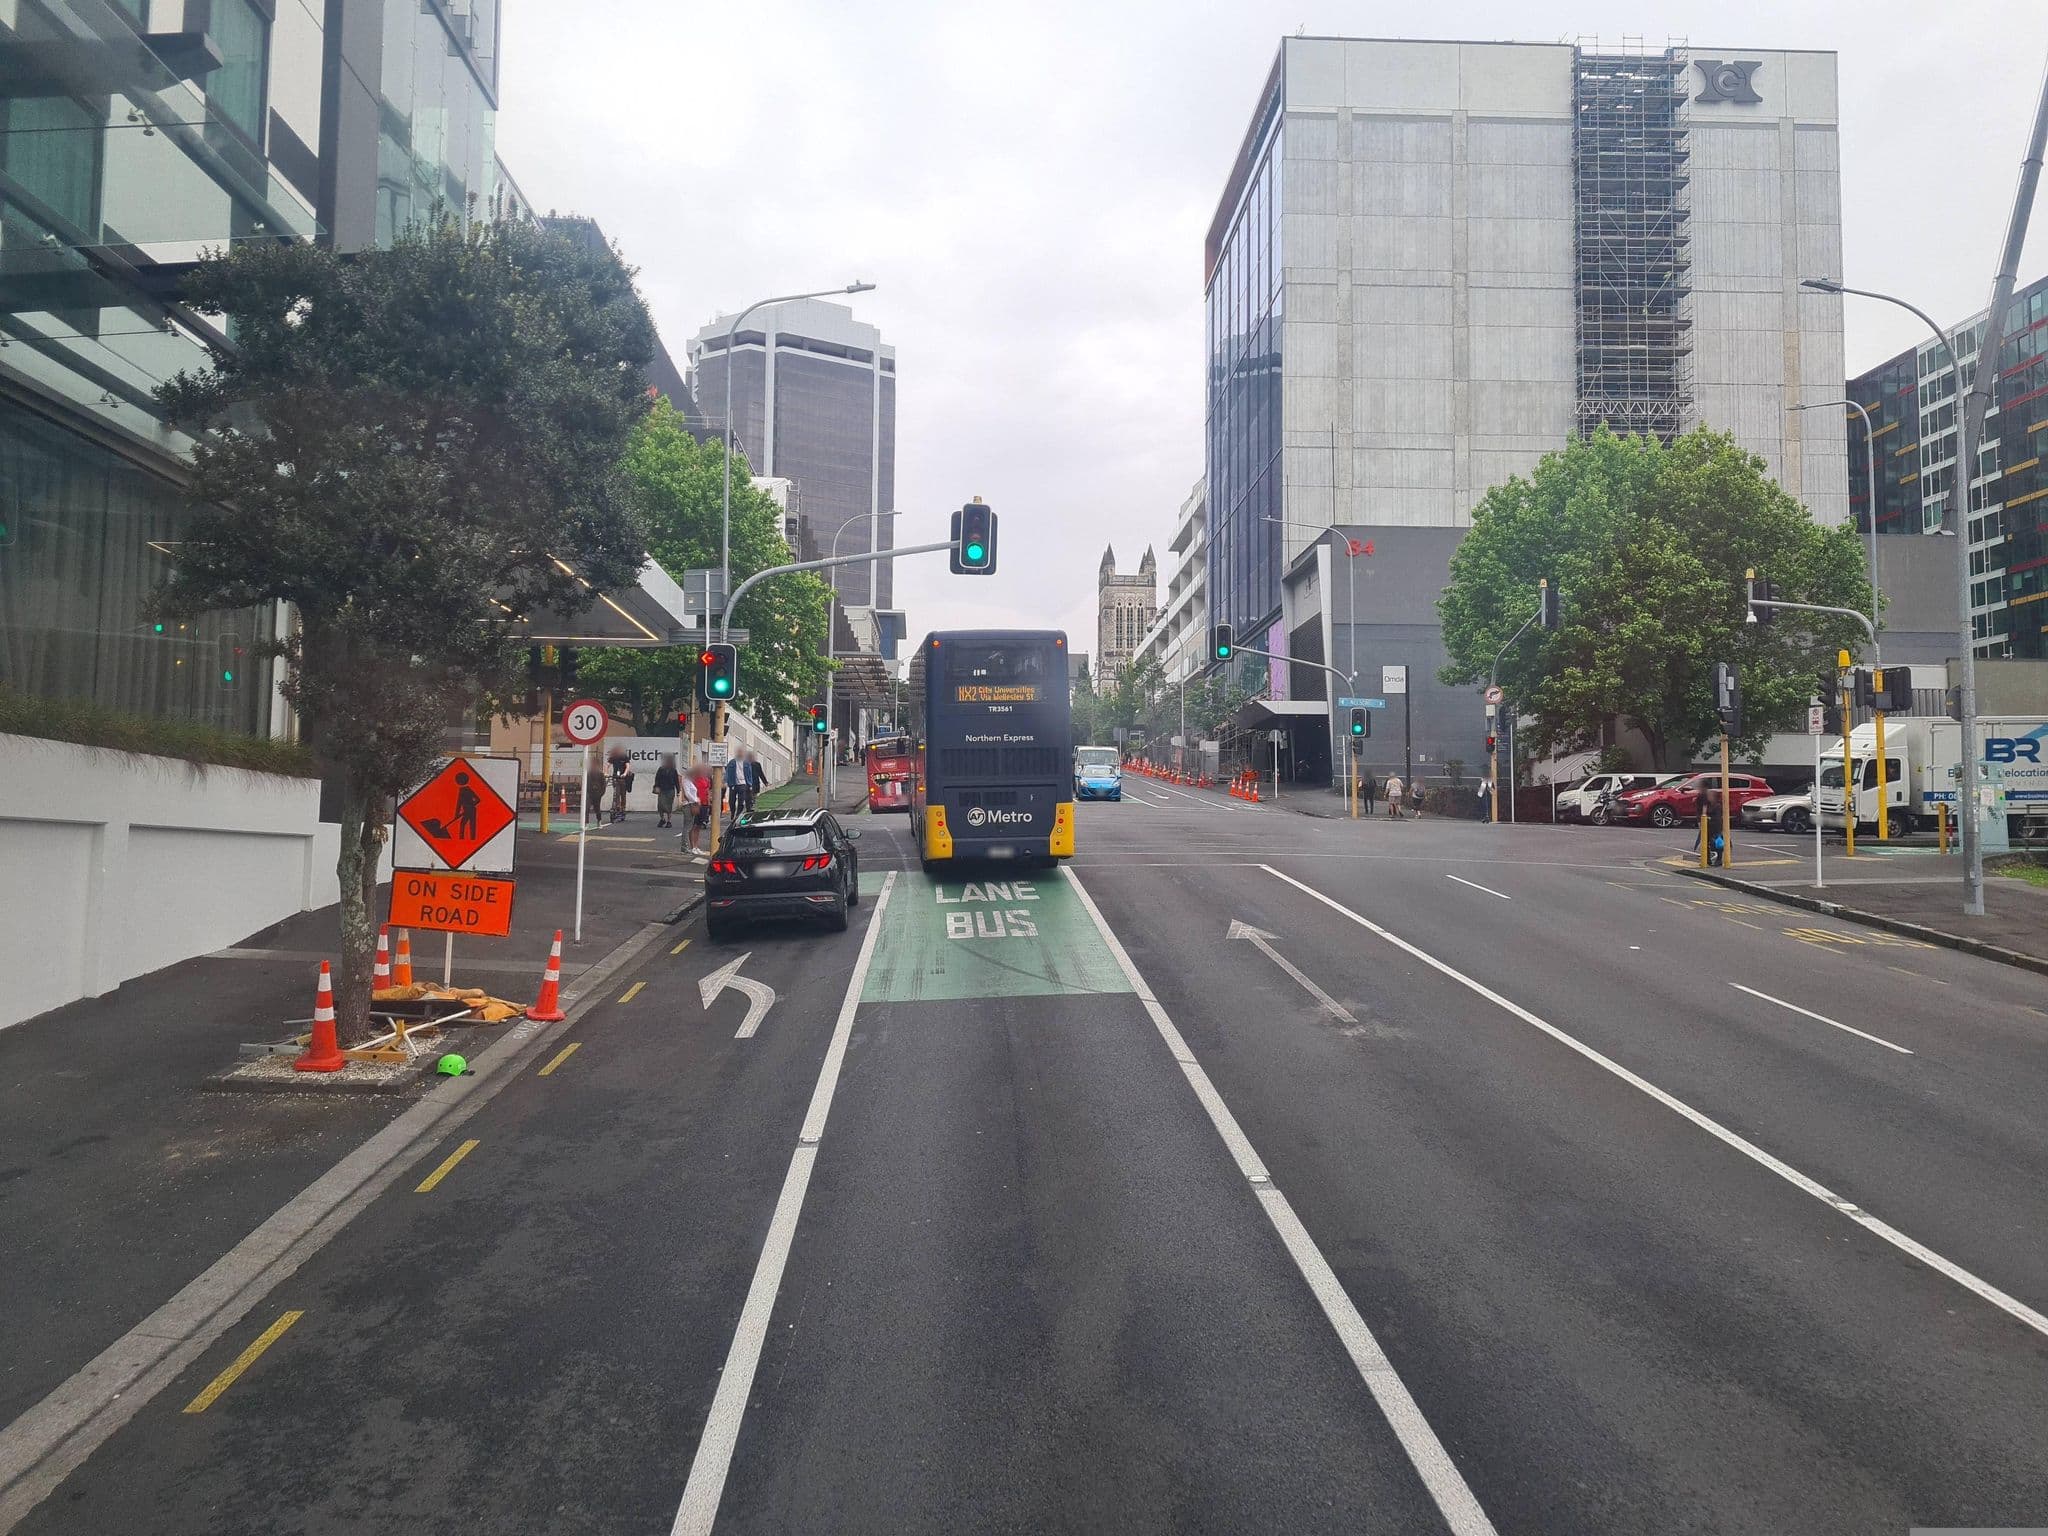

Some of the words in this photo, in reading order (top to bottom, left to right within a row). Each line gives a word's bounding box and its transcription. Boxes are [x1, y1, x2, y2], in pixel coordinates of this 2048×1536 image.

[959, 686, 977, 701] NX2
[978, 686, 992, 694] City
[994, 686, 1035, 694] Universities
[573, 714, 598, 731] 30
[965, 734, 1001, 742] Northern
[1003, 734, 1034, 744] Express
[621, 749, 679, 761] letchr
[1985, 738, 2041, 763] BR
[2003, 768, 2048, 778] elocatio
[988, 809, 1032, 823] Metro
[407, 879, 438, 898] ON
[450, 883, 498, 904] SIDE
[935, 880, 1041, 904] LANE
[420, 905, 480, 926] ROAD
[946, 909, 1039, 940] BUS
